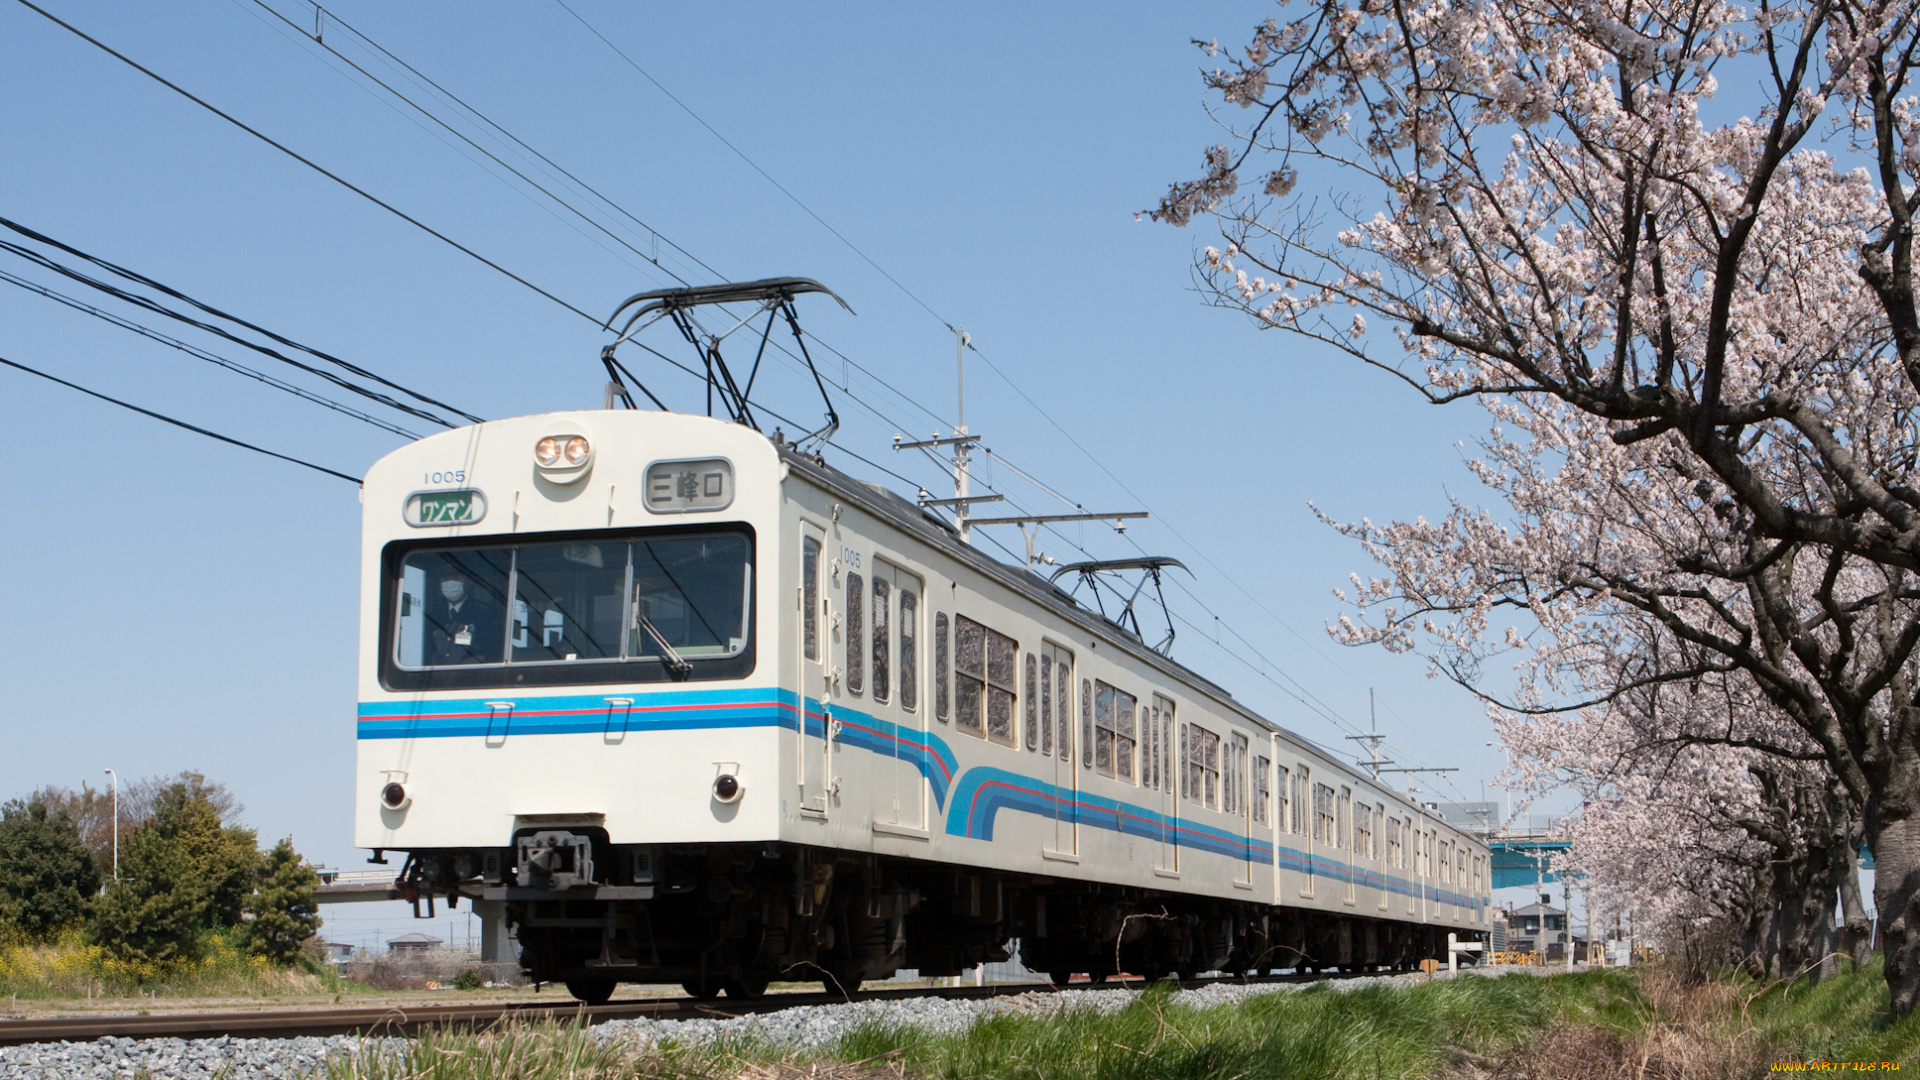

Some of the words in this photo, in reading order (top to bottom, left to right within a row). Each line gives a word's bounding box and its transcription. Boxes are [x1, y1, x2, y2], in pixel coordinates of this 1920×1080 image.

[424, 470, 466, 485] 1005
[651, 470, 723, 503] 三峰口
[422, 499, 473, 522] ワンマン
[840, 544, 861, 569] 1005
